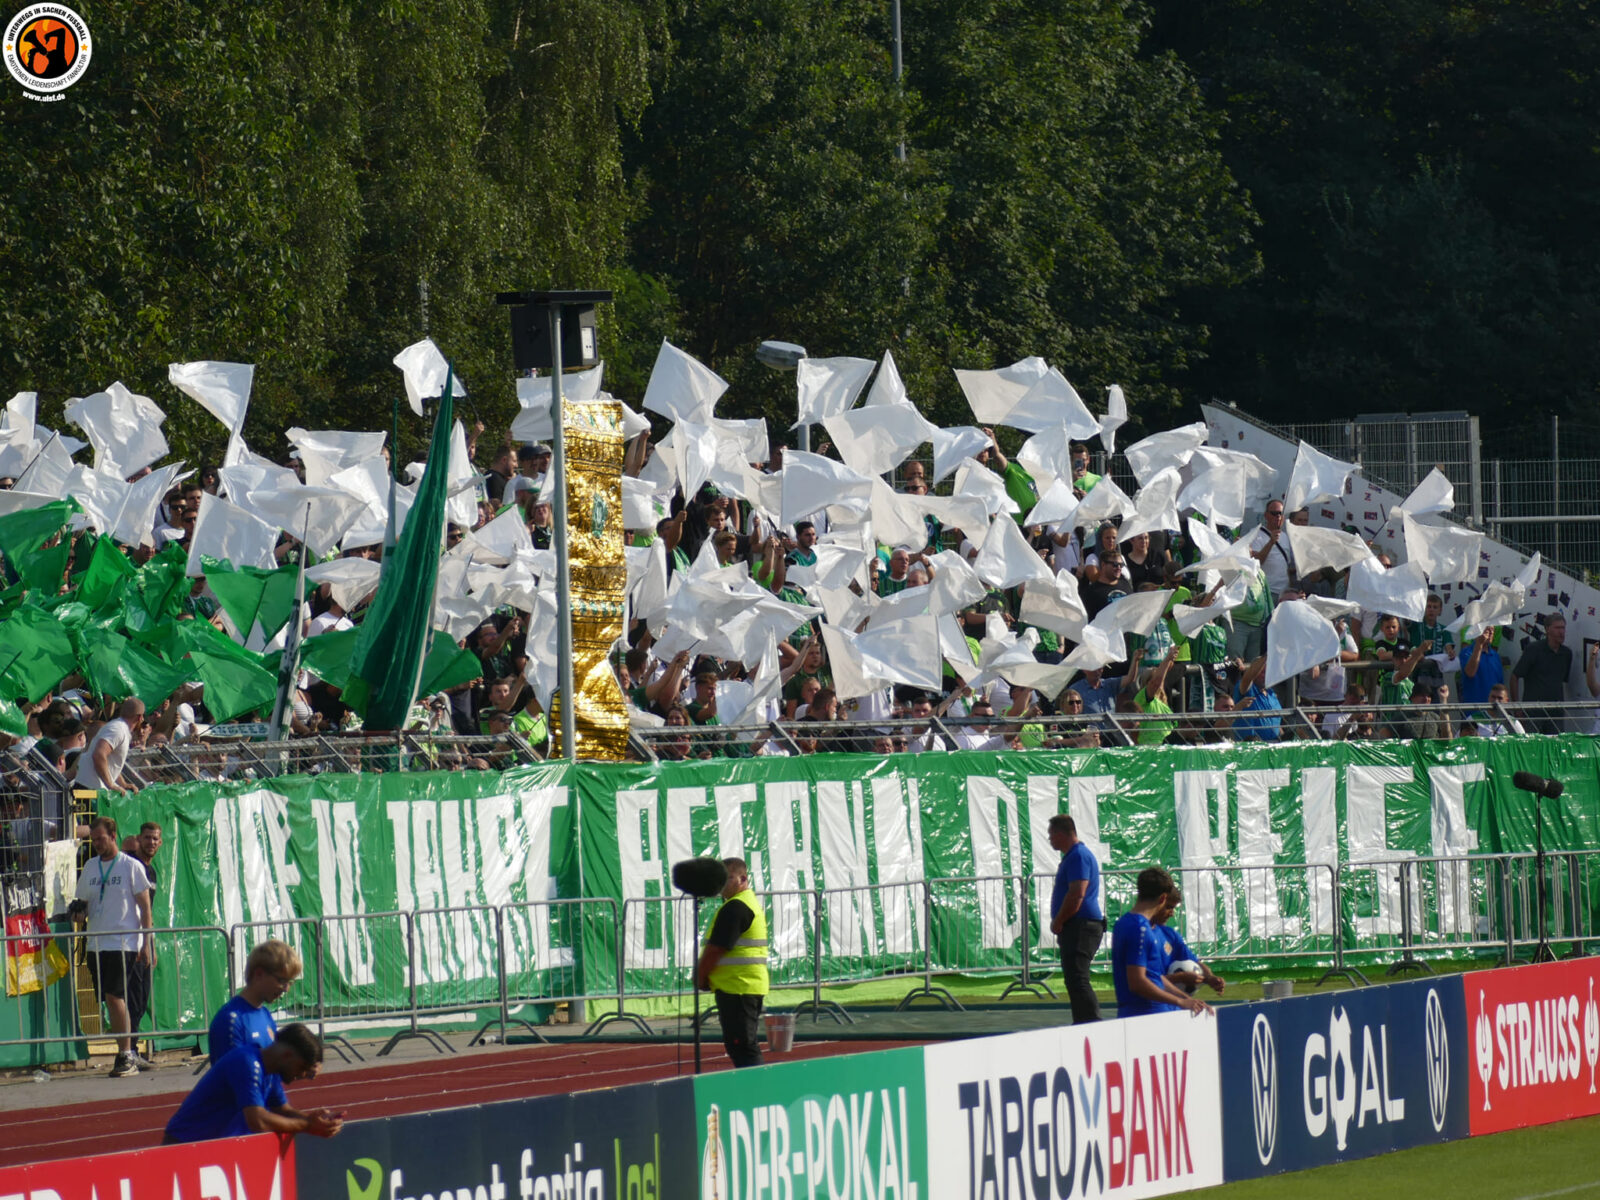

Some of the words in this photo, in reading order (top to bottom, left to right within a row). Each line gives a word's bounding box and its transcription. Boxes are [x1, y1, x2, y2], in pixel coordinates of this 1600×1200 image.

[1174, 762, 1486, 943] REISE
[1303, 1005, 1405, 1151] GOAL
[1496, 995, 1581, 1091] STRAUSS
[729, 1086, 918, 1200] DFB-POKAL
